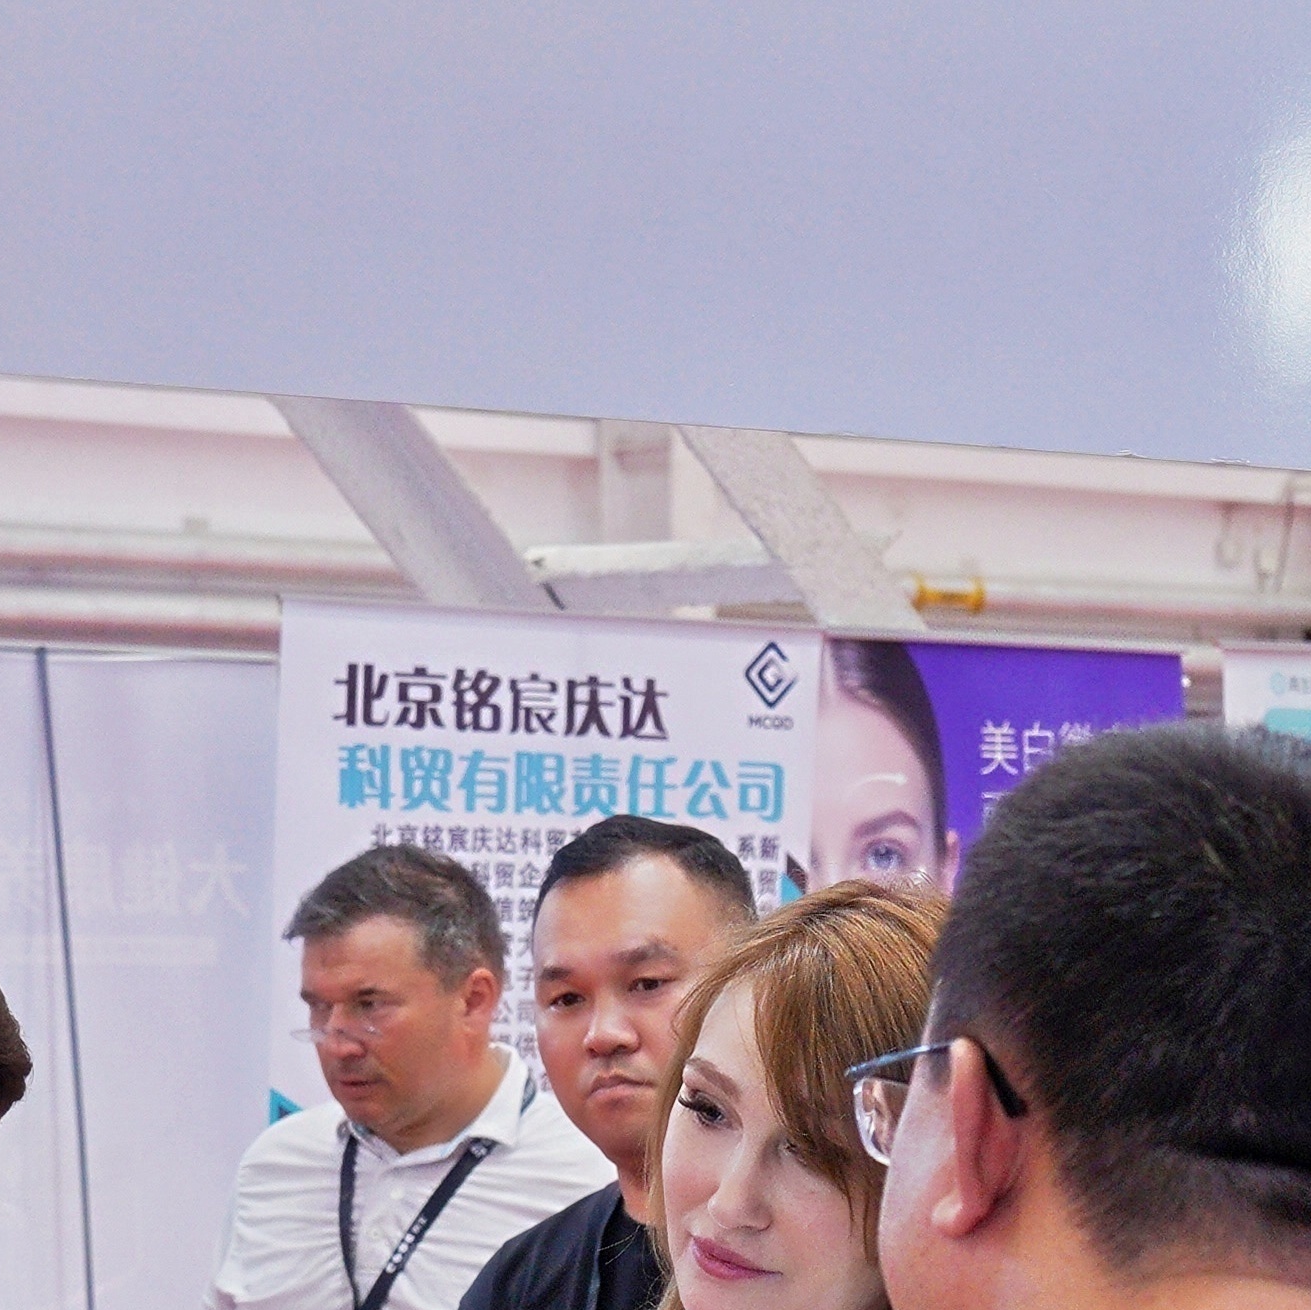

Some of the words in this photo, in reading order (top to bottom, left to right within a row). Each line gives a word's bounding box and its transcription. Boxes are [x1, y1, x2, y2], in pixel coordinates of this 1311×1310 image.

[333, 662, 669, 741] 北京铭宸庆达
[338, 743, 785, 823] 科贸有限责任公司
